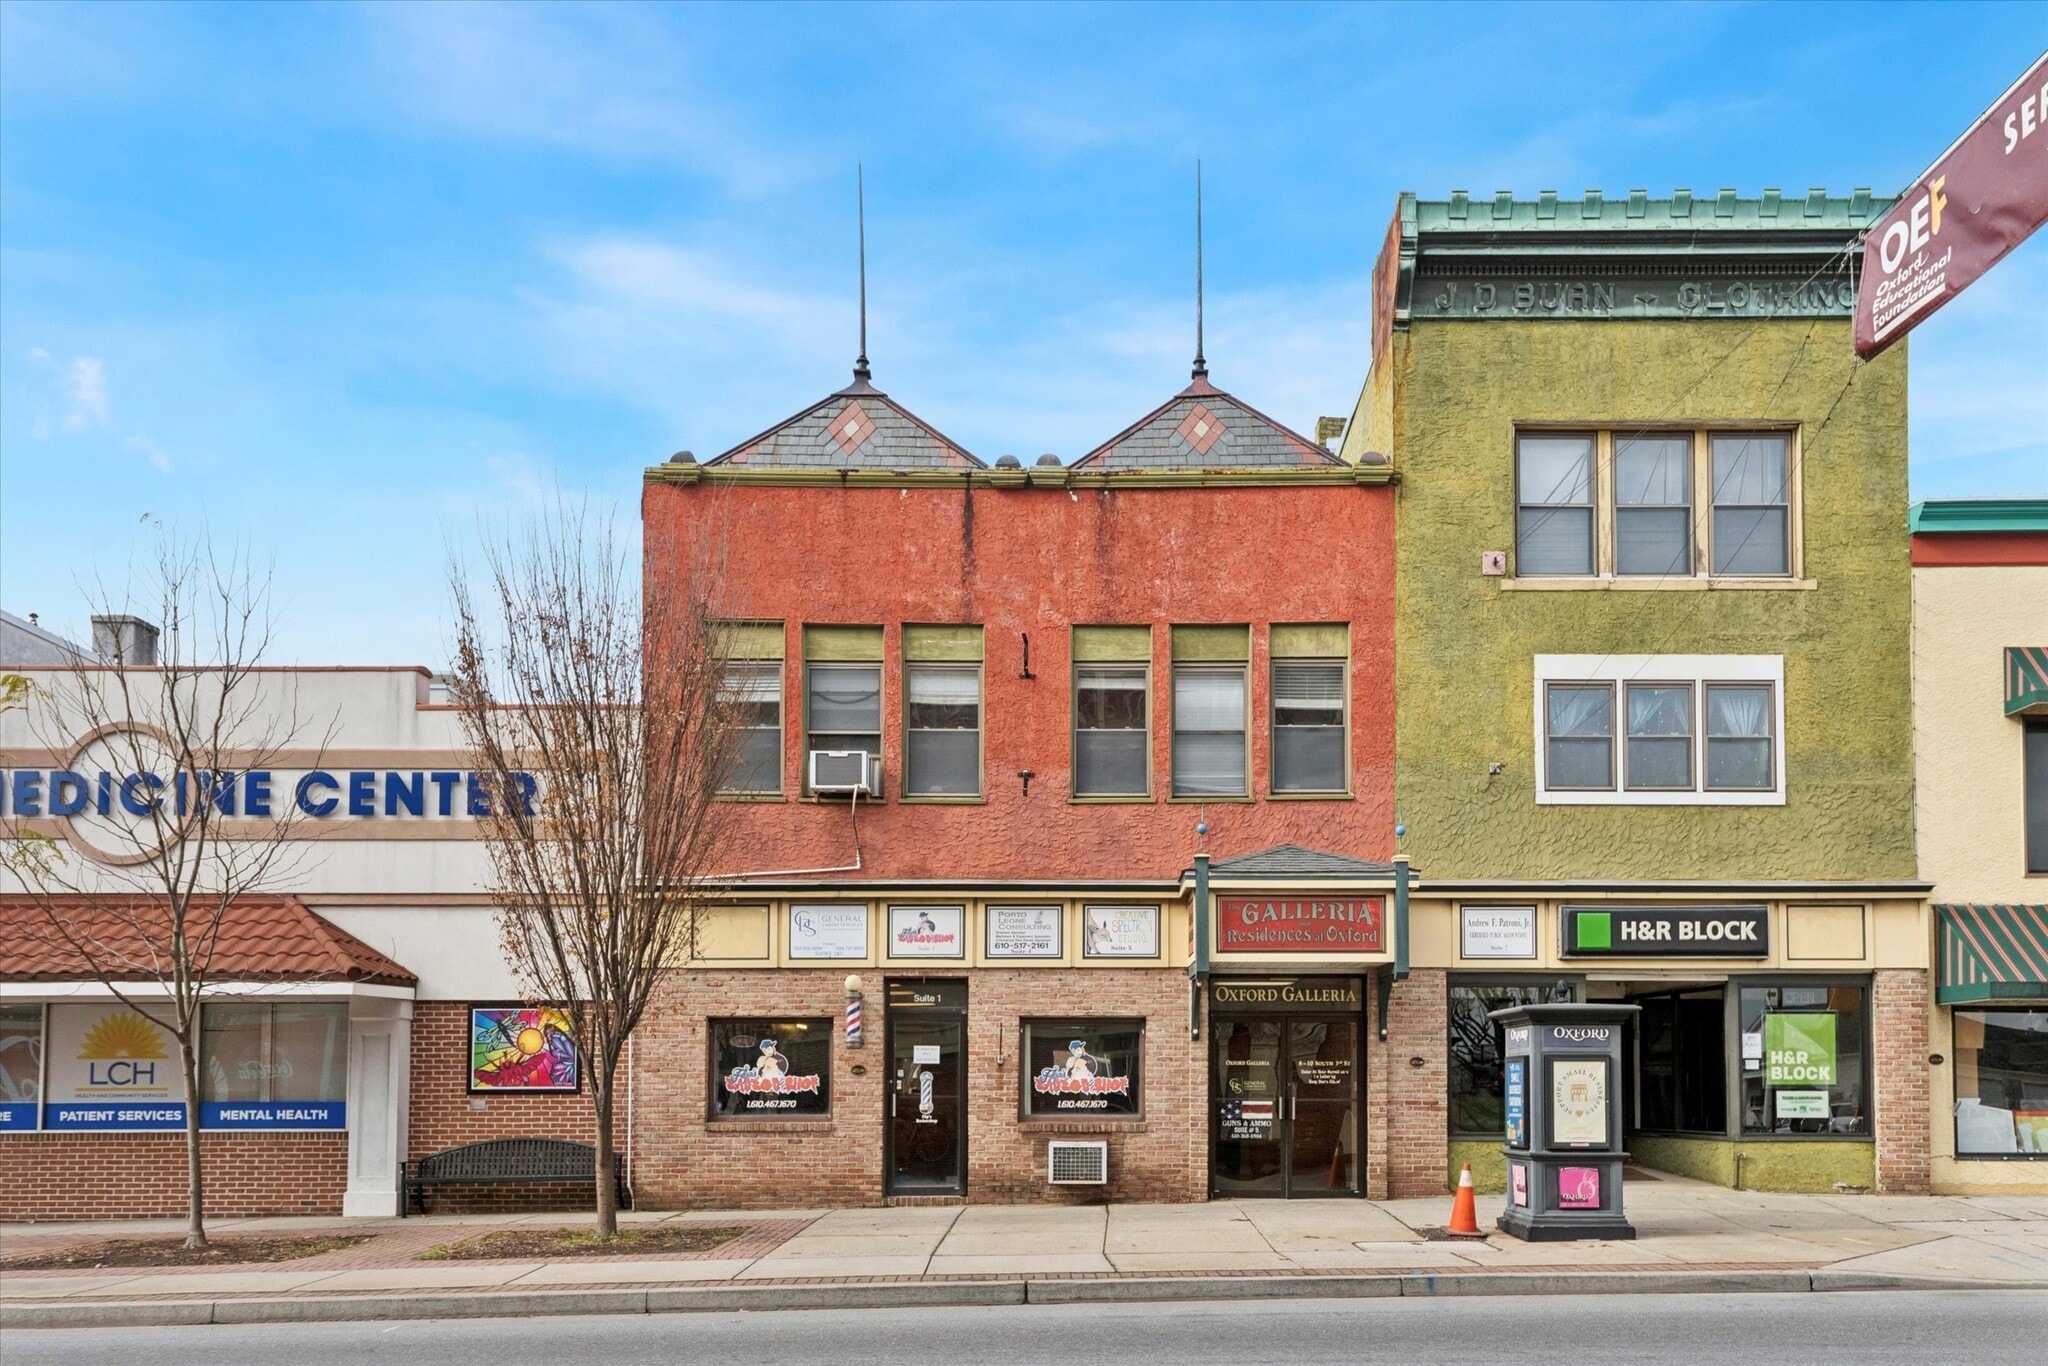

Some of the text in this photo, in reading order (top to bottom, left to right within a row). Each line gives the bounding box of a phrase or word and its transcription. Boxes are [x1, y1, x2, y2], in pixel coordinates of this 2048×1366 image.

[1880, 174, 1948, 275] OEF
[1872, 246, 1952, 315] Educational
[1876, 252, 1930, 297] Oxford
[1435, 282, 1857, 313] J D BURN CLOTHING
[1873, 272, 1946, 332] Foundation
[0, 771, 537, 817] EDICINE CENTER
[1115, 911, 1149, 919] CREATIVE
[1241, 902, 1374, 925] GALLERIA
[1467, 918, 1489, 927] Andrew
[1492, 918, 1498, 927] F.
[1226, 925, 1377, 945] Residences at Oxford
[1621, 921, 1758, 941] H&R BLOCK
[913, 994, 942, 1002] Suite 1
[1215, 986, 1356, 1002] OXFORD GALLERIA
[1784, 991, 1815, 1004] OPEN
[1553, 1026, 1610, 1042] OXFORD
[1770, 1050, 1809, 1065] H&R
[89, 1061, 155, 1086] LCH
[1770, 1066, 1831, 1080] BLOCK
[1555, 1069, 1604, 1115] SUPPORT SMALL BUSINESSES
[0, 1111, 12, 1122] E
[59, 1110, 182, 1121] PATIENT SERVICES
[219, 1110, 328, 1121] MENTAL HEALTH
